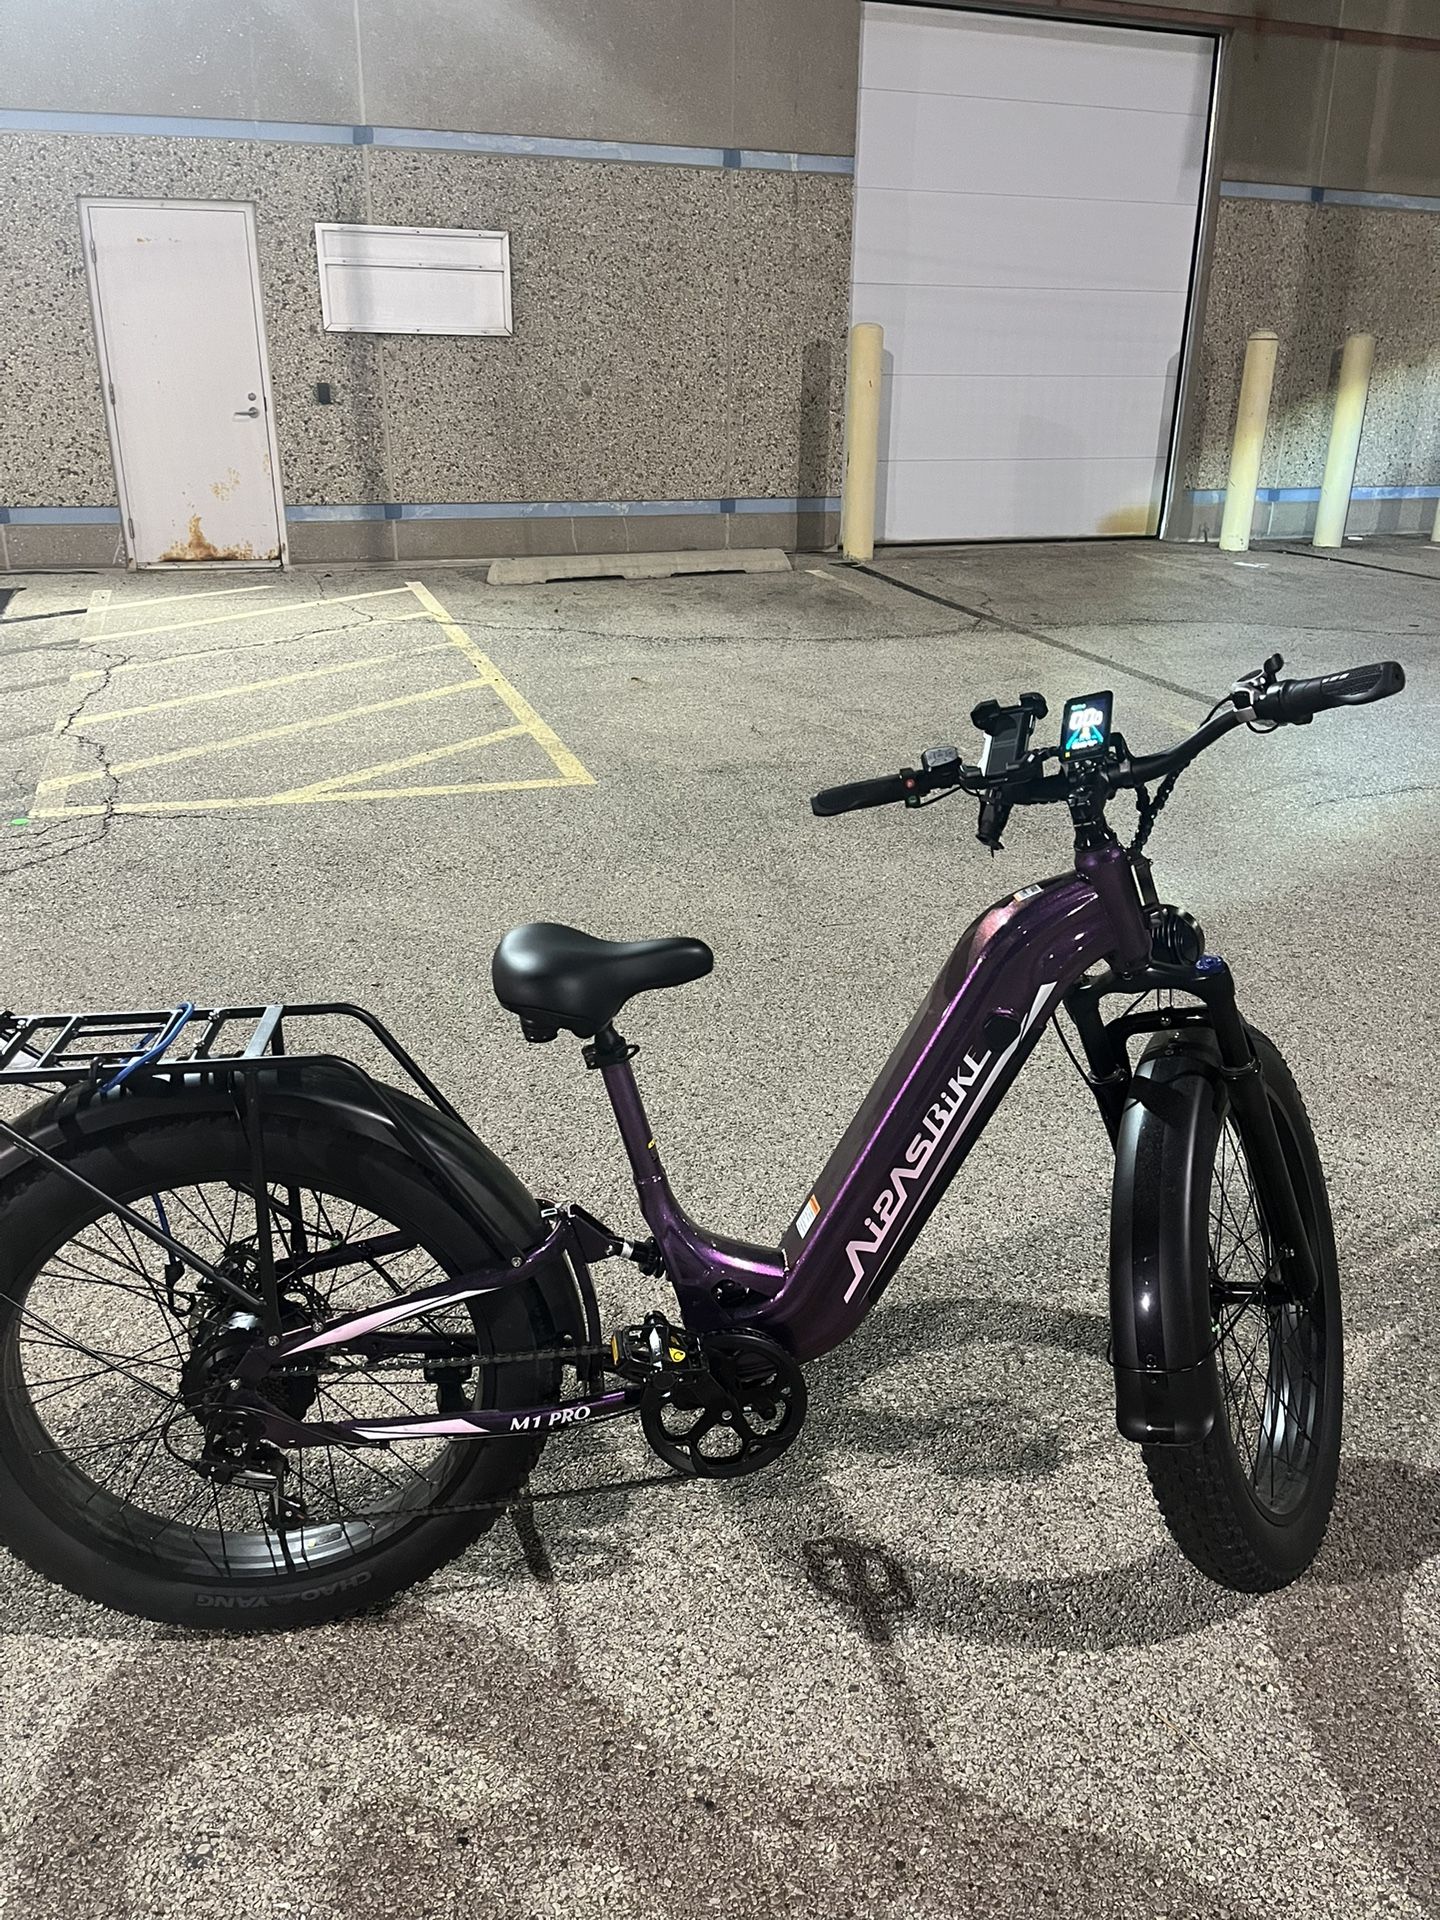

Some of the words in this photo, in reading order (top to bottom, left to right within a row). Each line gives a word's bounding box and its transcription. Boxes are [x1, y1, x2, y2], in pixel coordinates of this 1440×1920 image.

[510, 1415, 541, 1431] M1
[548, 1406, 591, 1426] PRO
[301, 1571, 372, 1600] CHAO
[195, 1594, 270, 1609] YANG
